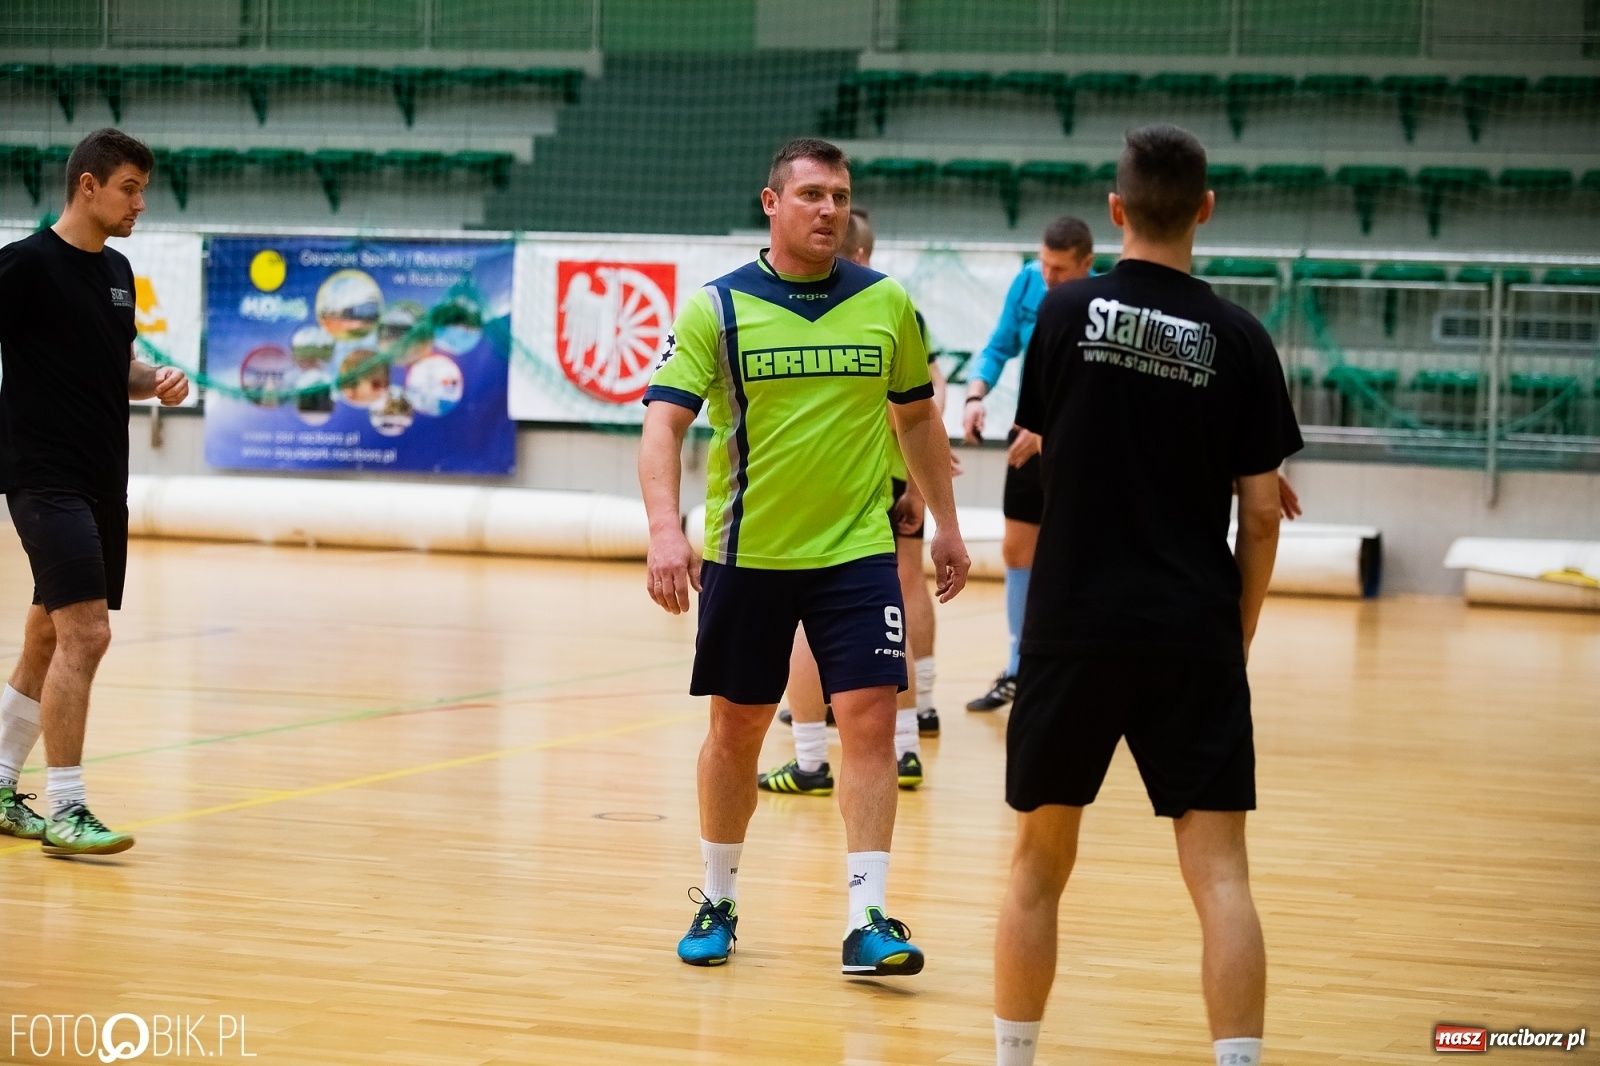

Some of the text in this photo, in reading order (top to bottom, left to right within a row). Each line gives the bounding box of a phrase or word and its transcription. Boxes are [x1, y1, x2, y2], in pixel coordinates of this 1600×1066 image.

[788, 292, 829, 301] regio
[1085, 297, 1217, 367] Staltech
[1083, 348, 1210, 388] www.staltech.pl
[884, 605, 903, 643] 9
